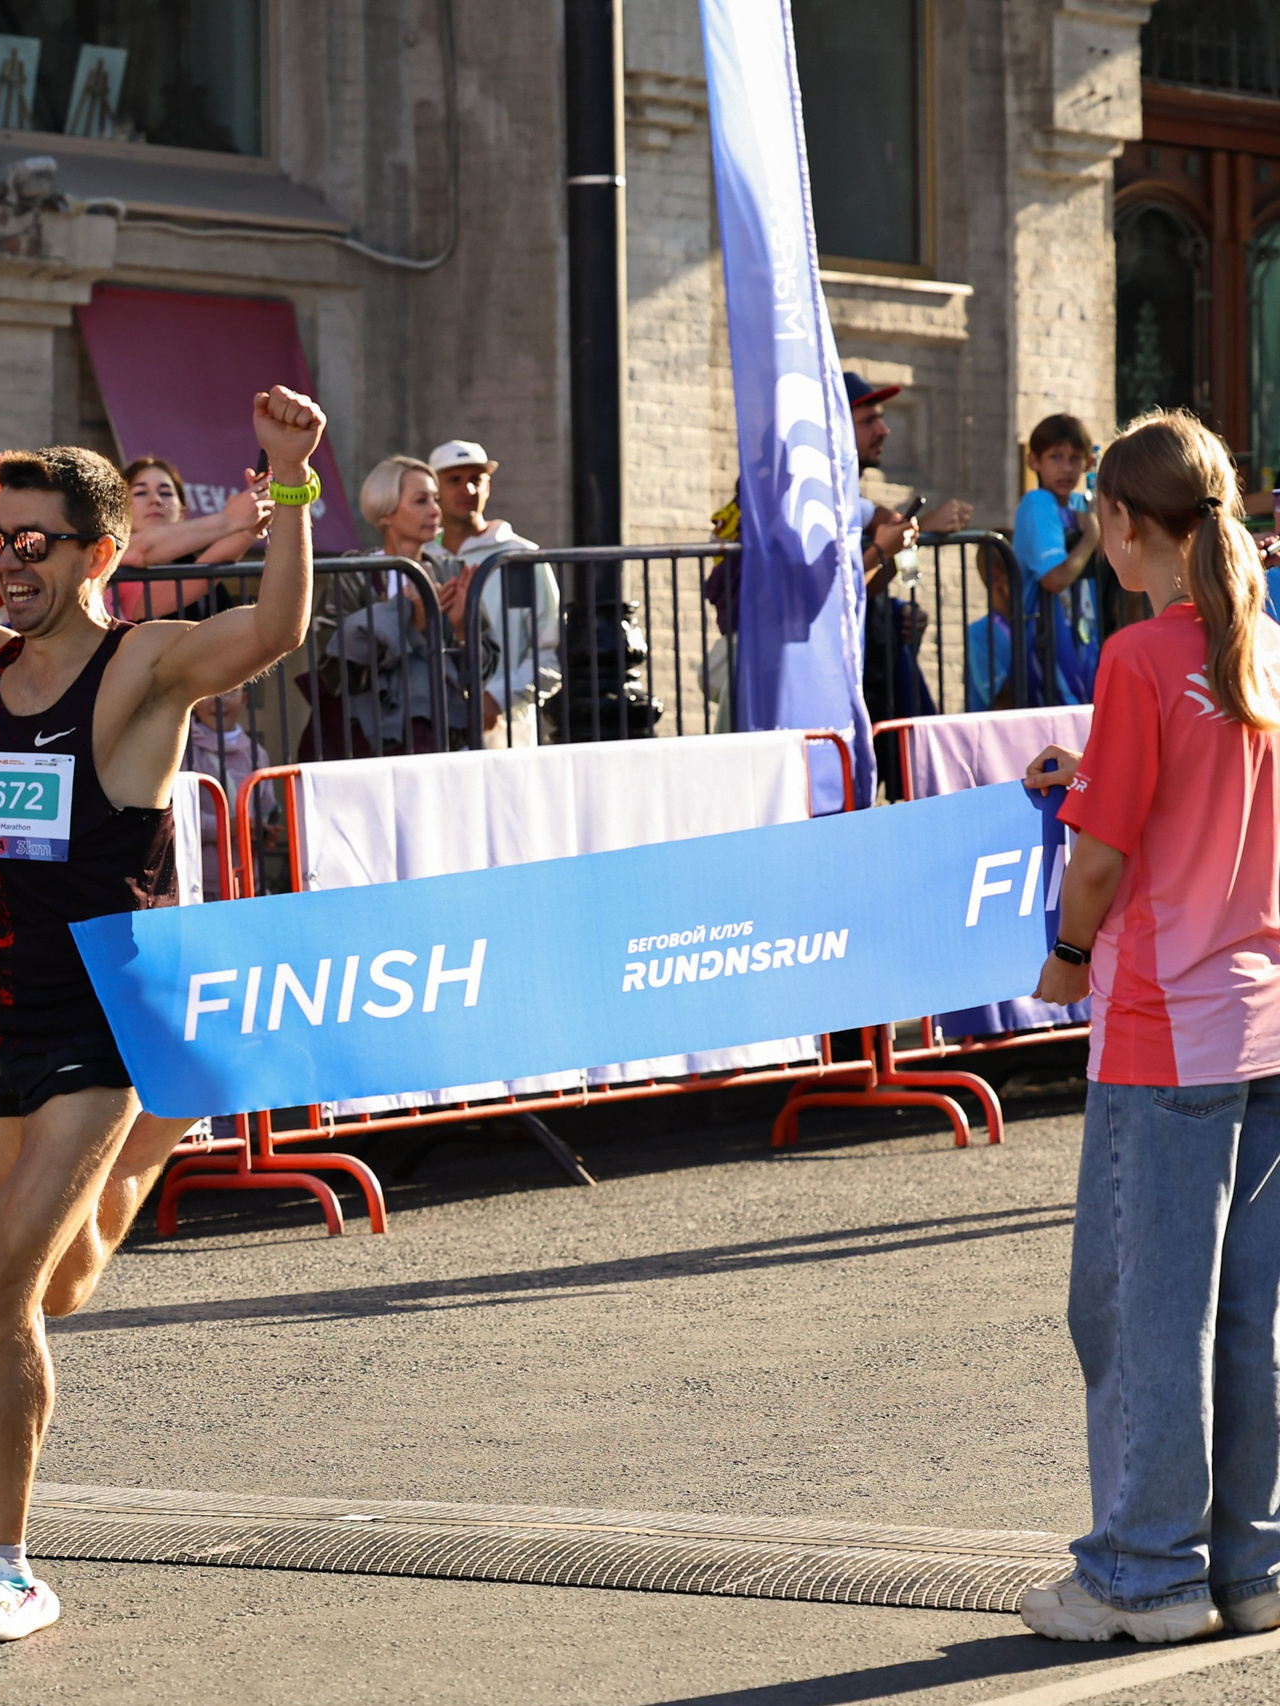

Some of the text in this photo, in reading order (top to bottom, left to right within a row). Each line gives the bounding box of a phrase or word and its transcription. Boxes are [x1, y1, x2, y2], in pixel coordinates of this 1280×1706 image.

[622, 928, 849, 992] RUNDNSRUN
[627, 920, 754, 954] БЕГОВОЙ КЛУБ
[184, 938, 487, 1042] FINISH
